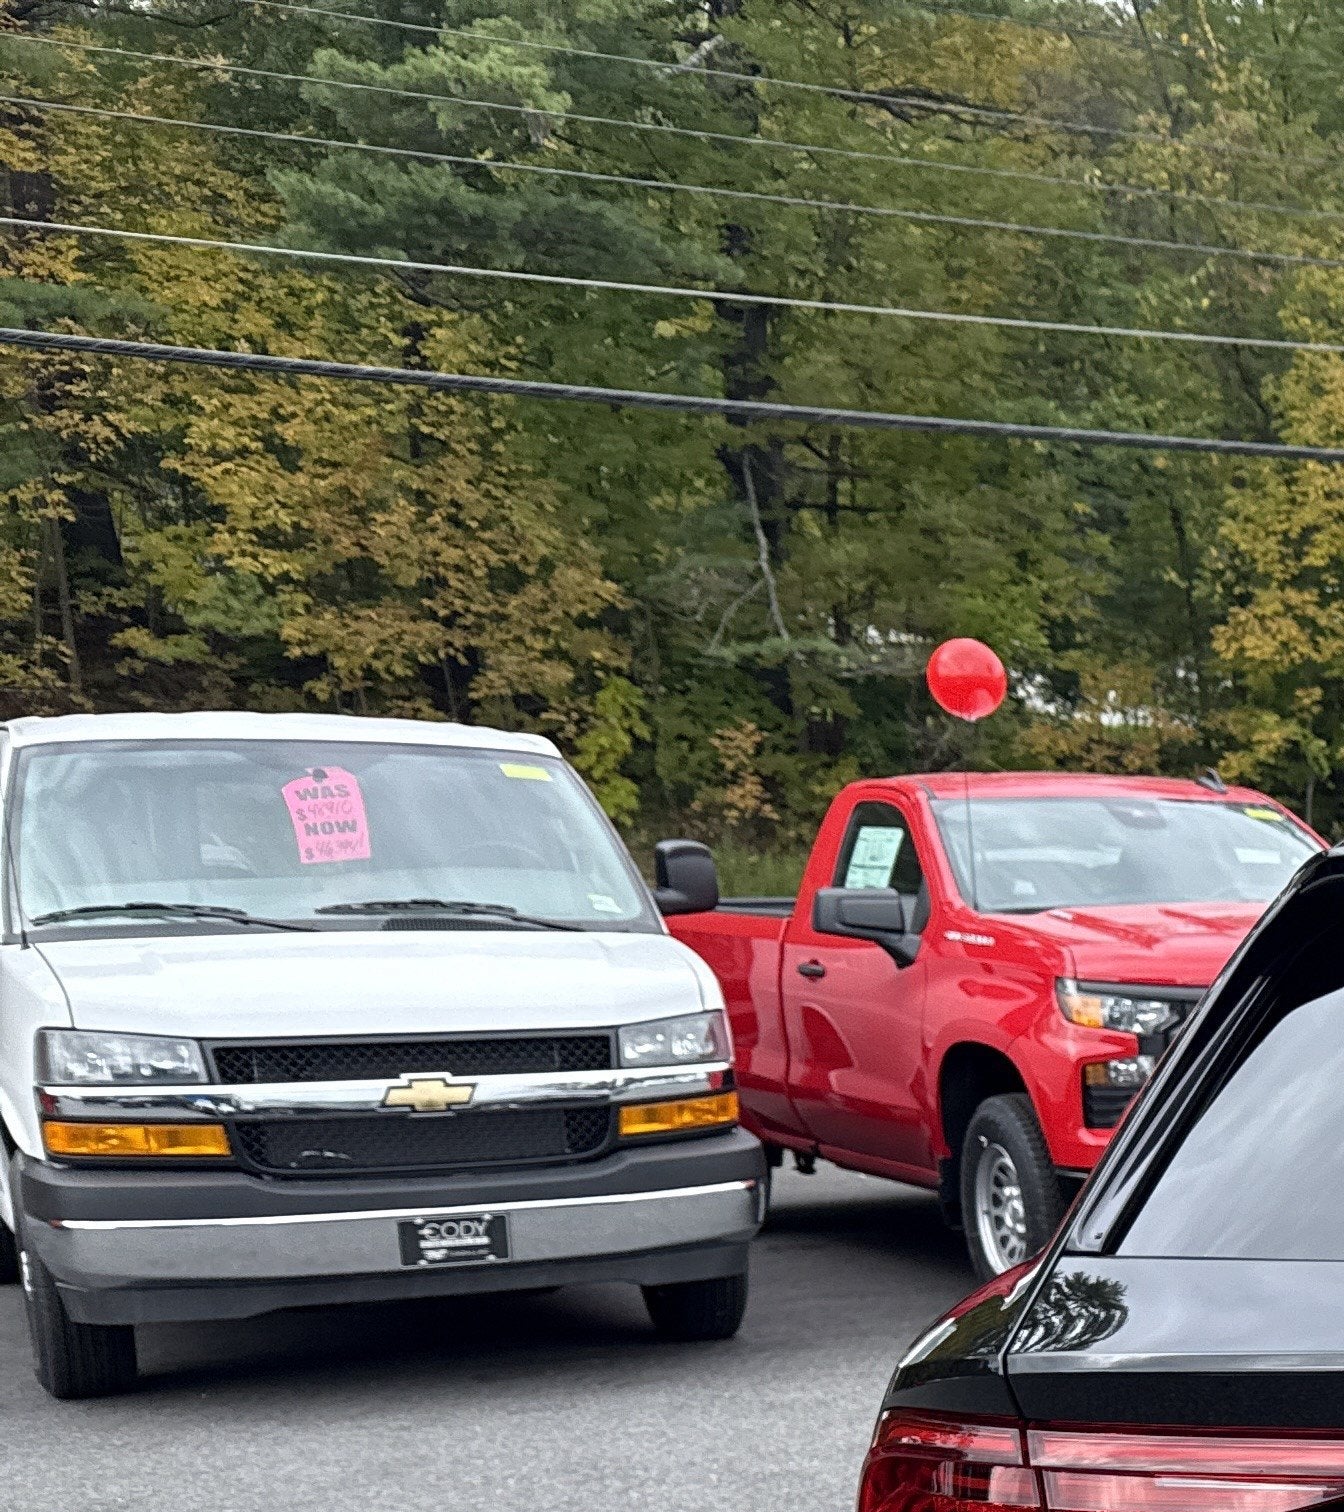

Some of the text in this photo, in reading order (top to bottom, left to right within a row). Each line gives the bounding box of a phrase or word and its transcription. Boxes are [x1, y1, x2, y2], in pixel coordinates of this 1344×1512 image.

[294, 784, 351, 801] WAS
[303, 820, 357, 836] NOW
[420, 1220, 487, 1240] CODY
